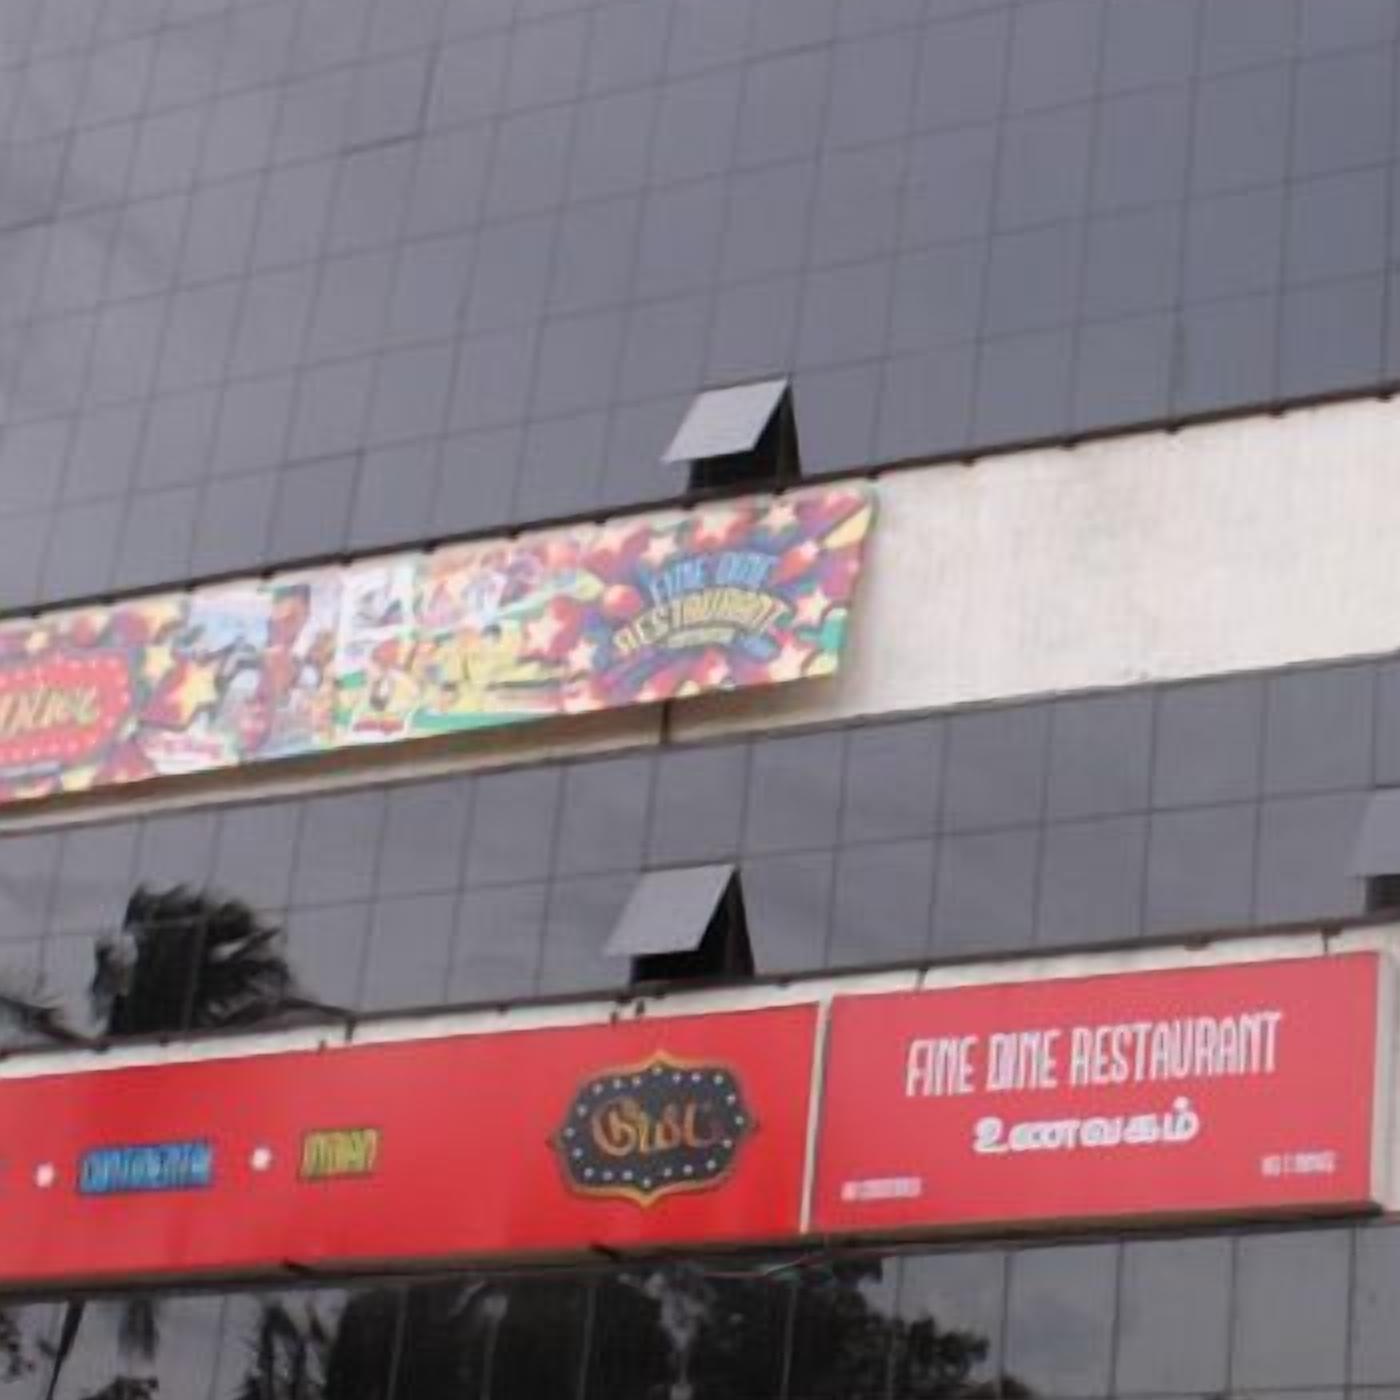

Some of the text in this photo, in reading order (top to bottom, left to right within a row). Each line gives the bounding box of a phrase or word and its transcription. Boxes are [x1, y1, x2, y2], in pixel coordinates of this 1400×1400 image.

[905, 1010, 1283, 1097] FINE DINE RESTAURANT
[973, 1096, 1200, 1154] உணவகம்
